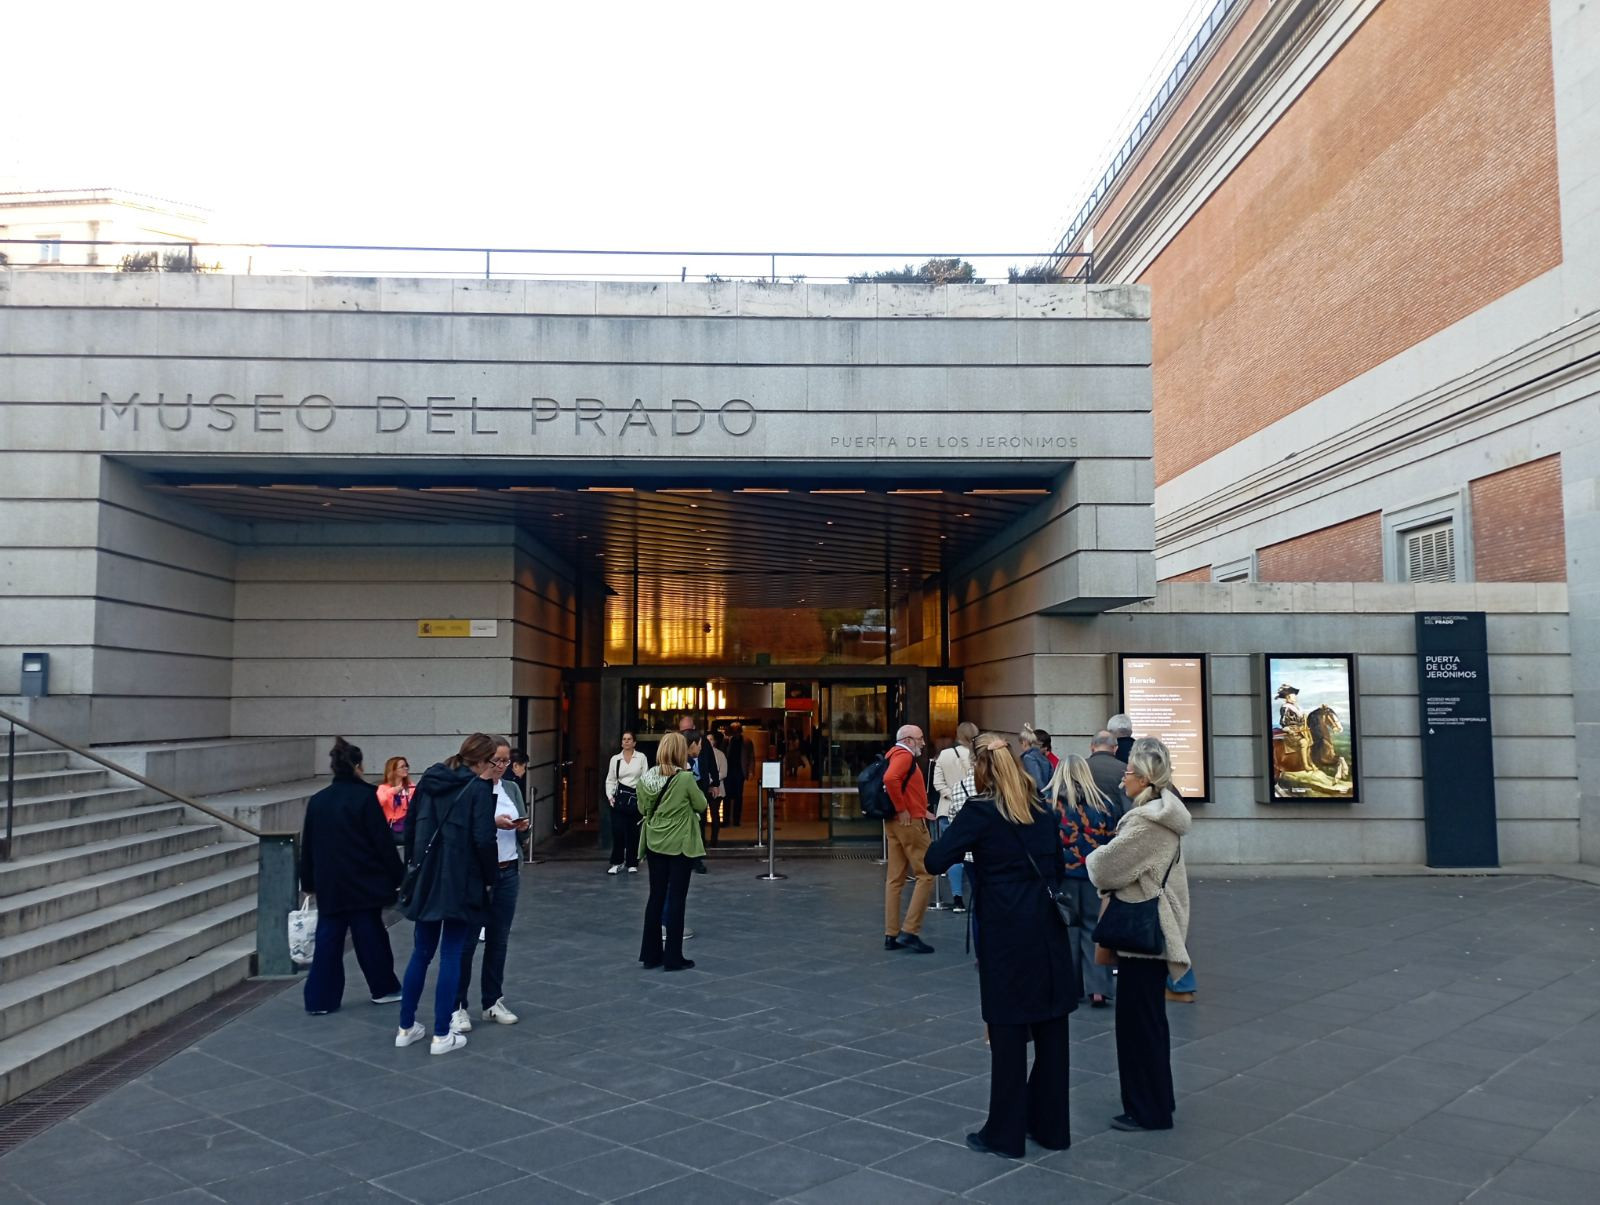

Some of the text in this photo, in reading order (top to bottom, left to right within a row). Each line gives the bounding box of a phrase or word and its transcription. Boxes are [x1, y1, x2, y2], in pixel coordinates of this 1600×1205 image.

[99, 391, 758, 438] MUSEO DEL PRADO
[830, 436, 898, 448] PUERTA
[906, 436, 929, 448] DE
[937, 436, 970, 448] LOS
[1426, 663, 1458, 671] DE LOS
[1426, 670, 1477, 679] JERÓNIMOS
